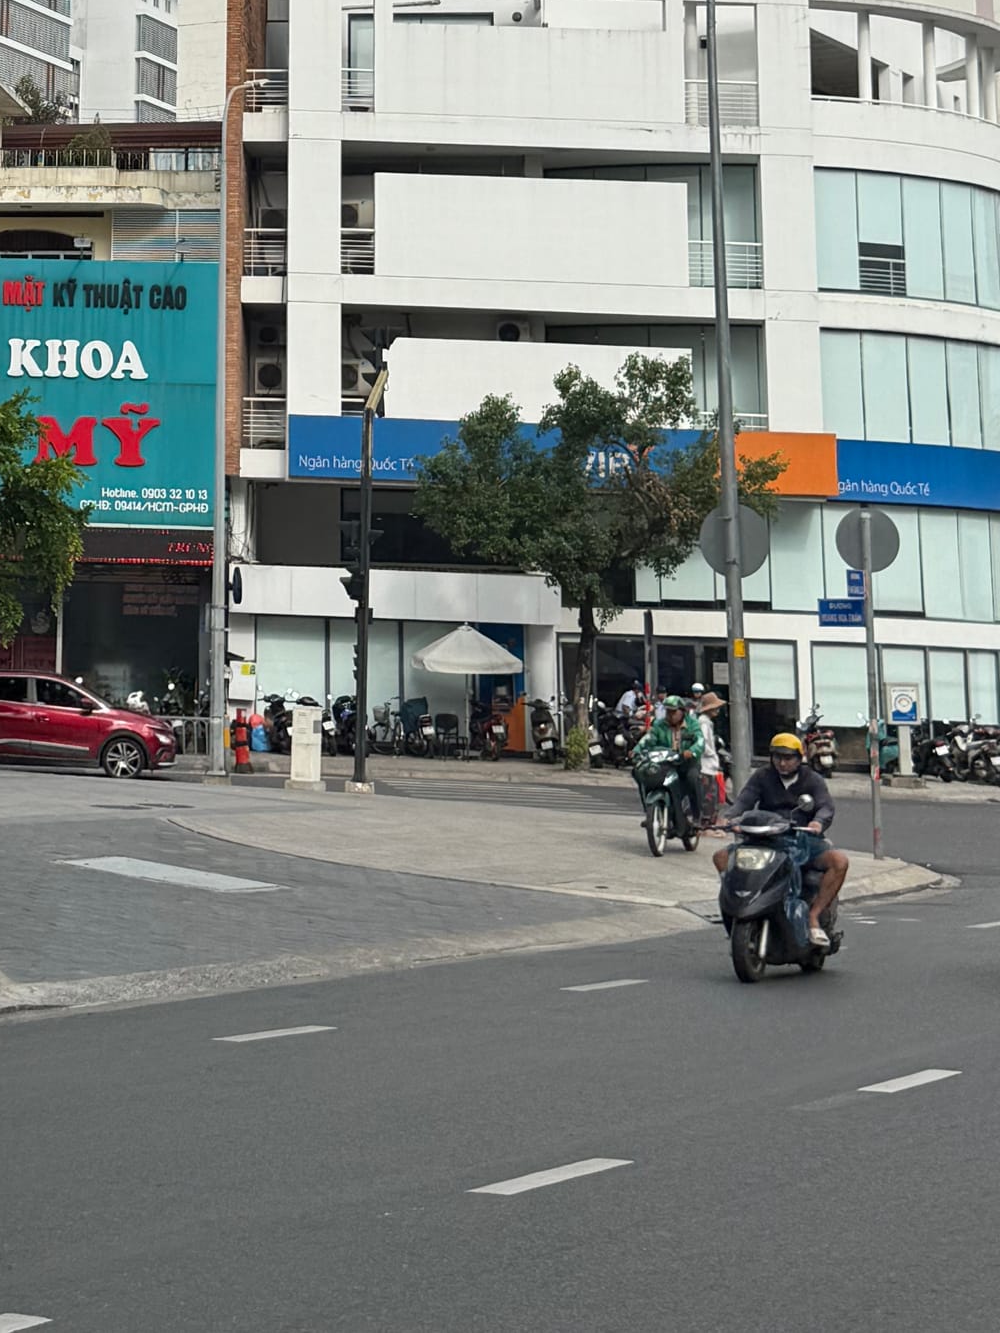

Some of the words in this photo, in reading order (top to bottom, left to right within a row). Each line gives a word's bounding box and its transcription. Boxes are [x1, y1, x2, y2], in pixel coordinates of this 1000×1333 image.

[2, 275, 46, 312] MẶT
[52, 277, 78, 308] KỸ
[82, 277, 144, 315] THUẬT
[149, 285, 187, 310] CAO
[6, 338, 149, 380] KHOA
[33, 403, 161, 467] MỸ
[298, 454, 330, 471] Ngân
[333, 455, 363, 472] hàng
[141, 488, 167, 499] 0903
[169, 489, 182, 499] 32
[185, 489, 195, 500] 10
[198, 489, 208, 500] 13
[838, 478, 859, 494] gân
[861, 479, 888, 497] hàng
[890, 481, 917, 496] Quốc
